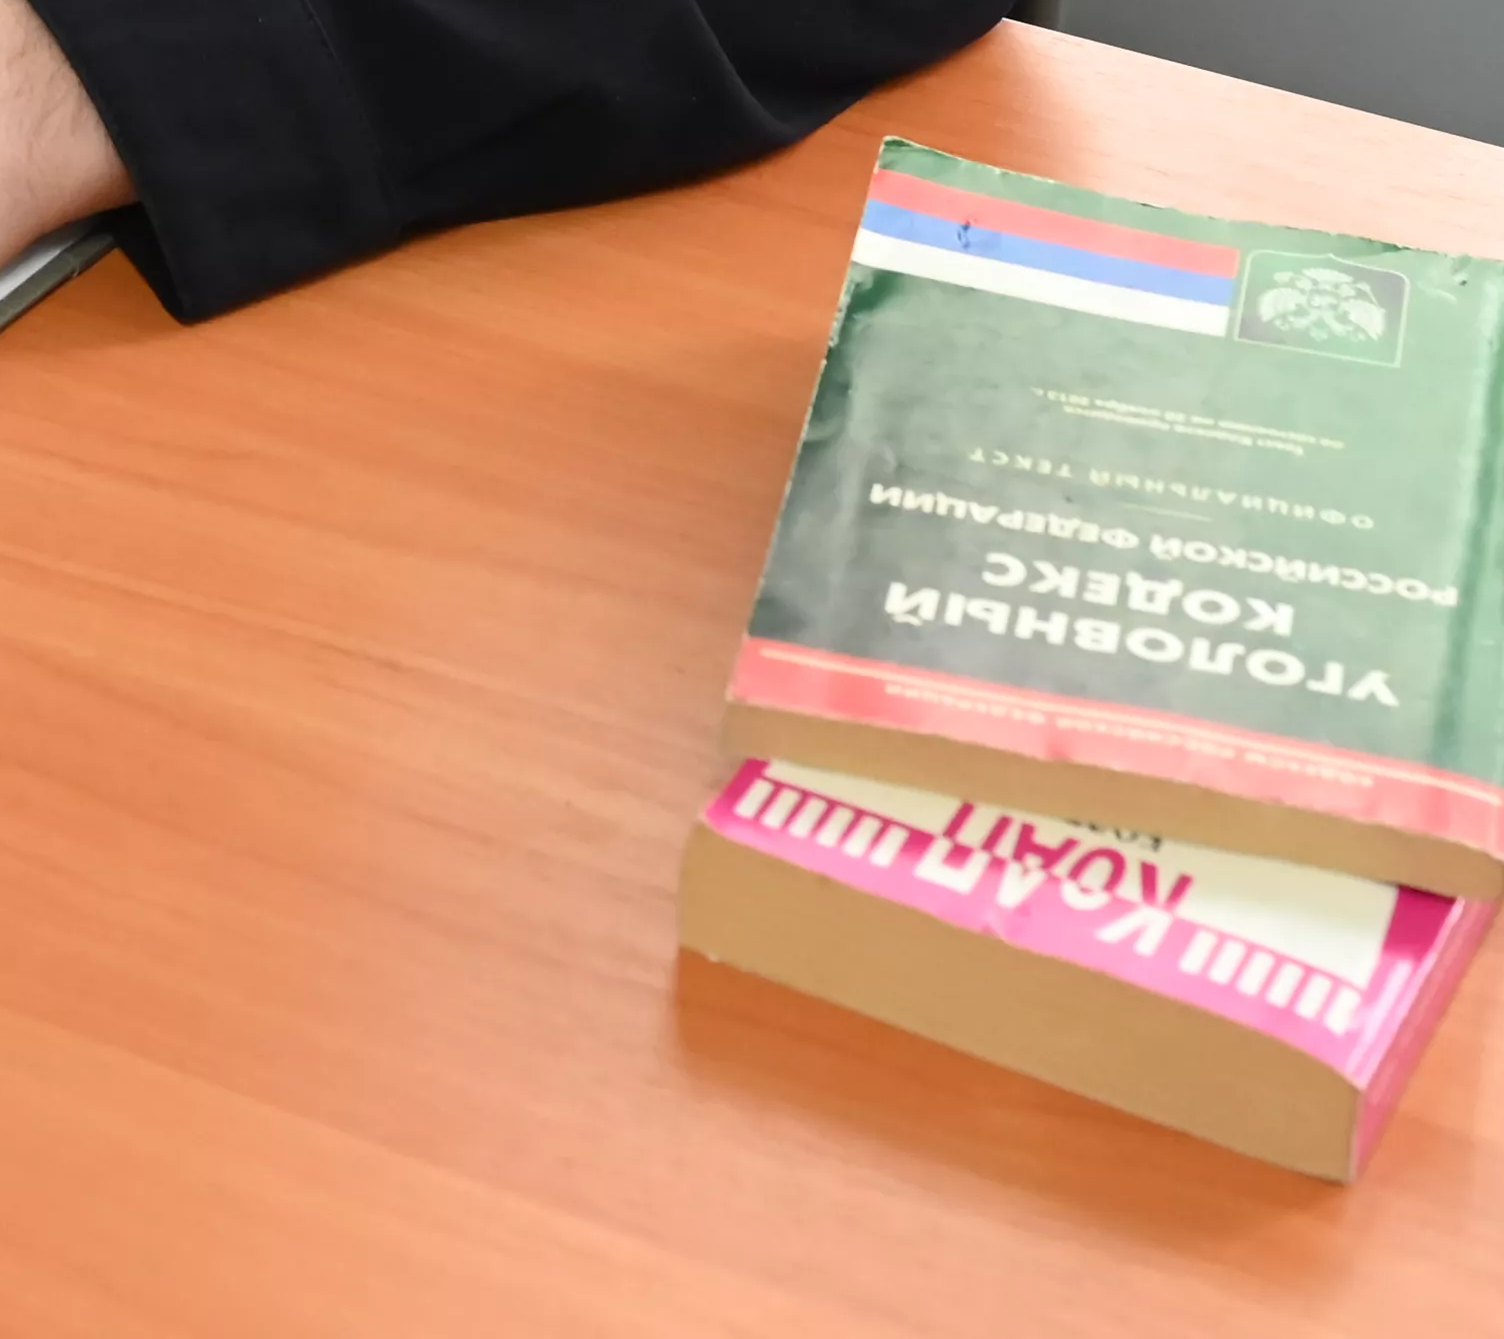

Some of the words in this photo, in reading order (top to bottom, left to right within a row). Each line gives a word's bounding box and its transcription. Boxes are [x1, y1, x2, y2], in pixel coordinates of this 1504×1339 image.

[969, 447, 1072, 478] ТЕКСТ
[870, 483, 1140, 549] ФЕДЕРАЦИИ
[1088, 468, 1374, 529] ОФИЦИАЛЬНЫЙ
[981, 552, 1294, 636] КОДЕКС
[1149, 533, 1458, 606] РОССИЙСКОЙ
[884, 582, 1400, 707] УГОЛОВНЫЙ
